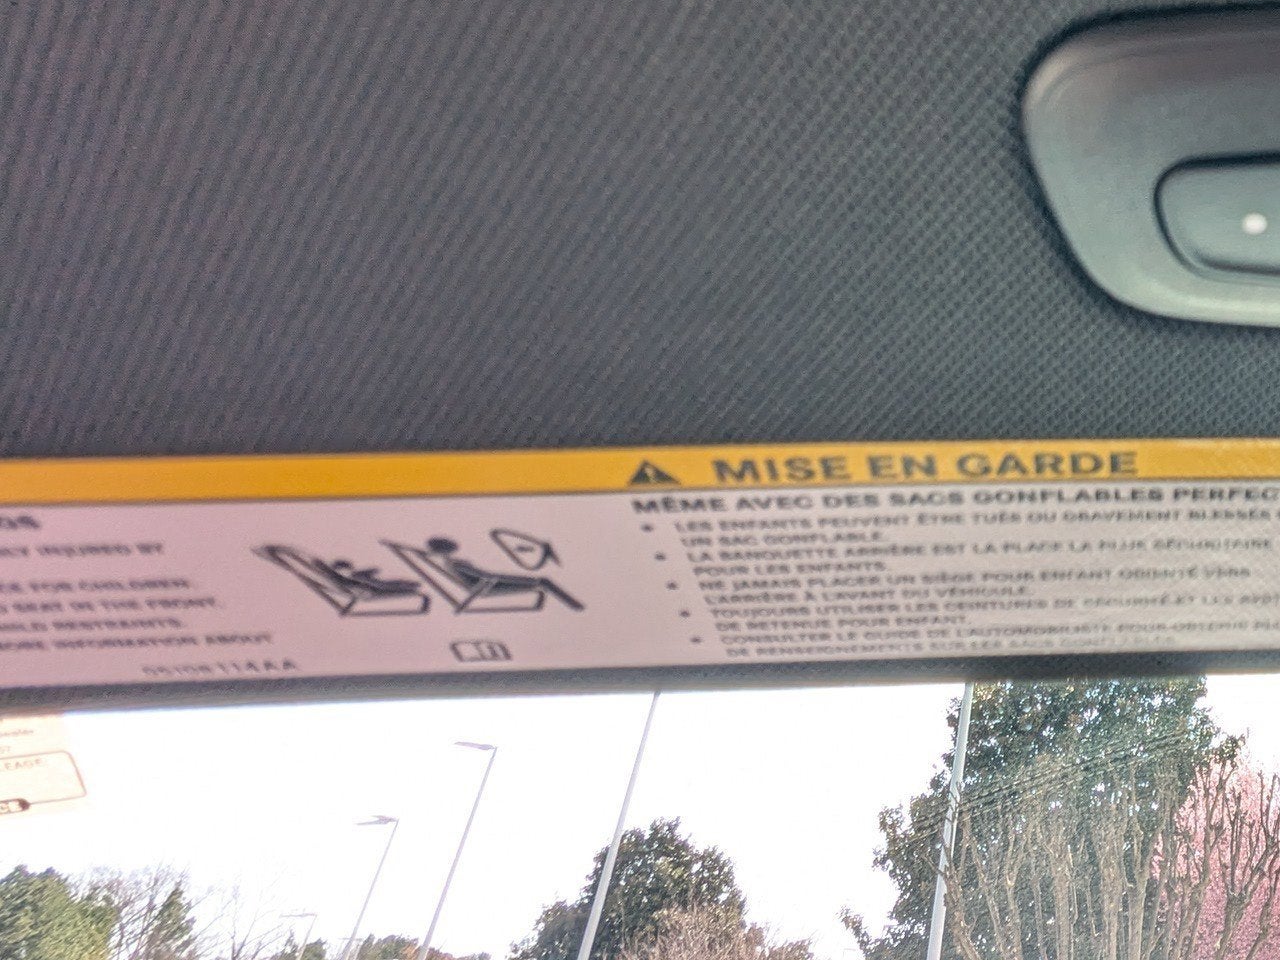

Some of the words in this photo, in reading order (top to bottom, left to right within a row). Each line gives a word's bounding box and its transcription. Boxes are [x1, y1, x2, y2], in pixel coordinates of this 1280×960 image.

[712, 455, 851, 482] MISE
[867, 454, 938, 477] EN
[957, 451, 1138, 476] GARDE
[631, 496, 727, 513] MÊME
[735, 495, 812, 511] AVEC
[822, 493, 879, 507] DES
[889, 492, 963, 506] SACS
[973, 489, 1163, 506] GONFLABLES
